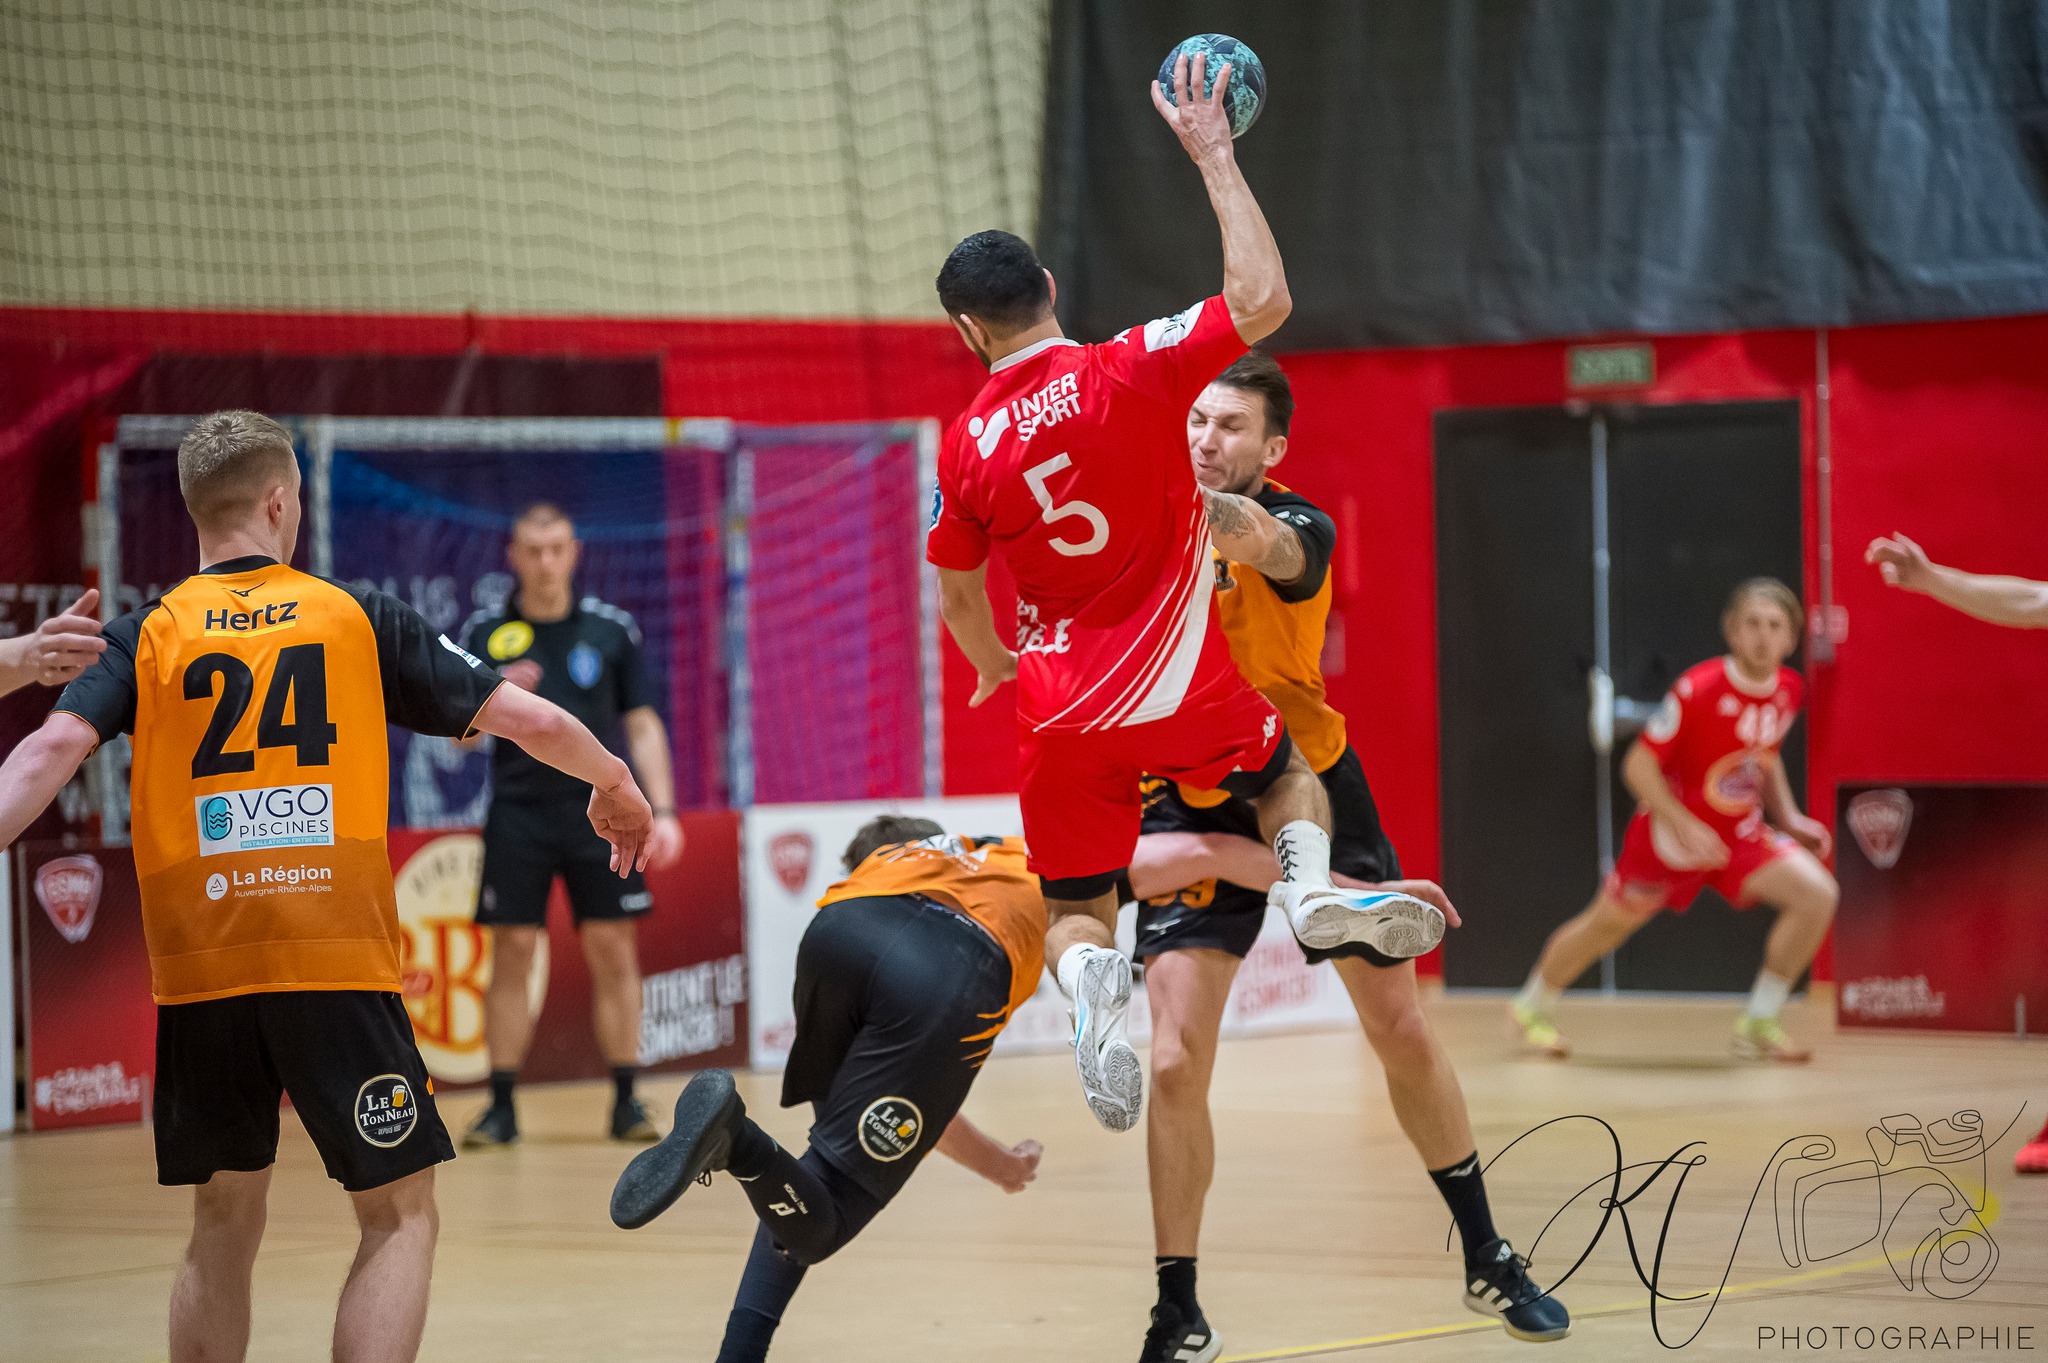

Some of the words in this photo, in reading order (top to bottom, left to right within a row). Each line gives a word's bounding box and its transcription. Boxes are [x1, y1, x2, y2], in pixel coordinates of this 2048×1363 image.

[1011, 372, 1078, 422] INTER
[1017, 392, 1081, 442] SPORT
[1022, 451, 1110, 558] 5
[205, 601, 299, 631] Hertz
[183, 643, 338, 780] 24
[238, 786, 329, 820] VGO
[240, 819, 329, 838] PISCINES
[233, 870, 256, 886] La
[260, 864, 332, 885] Région
[234, 884, 332, 898] Auvergne-Rhône-Alpes
